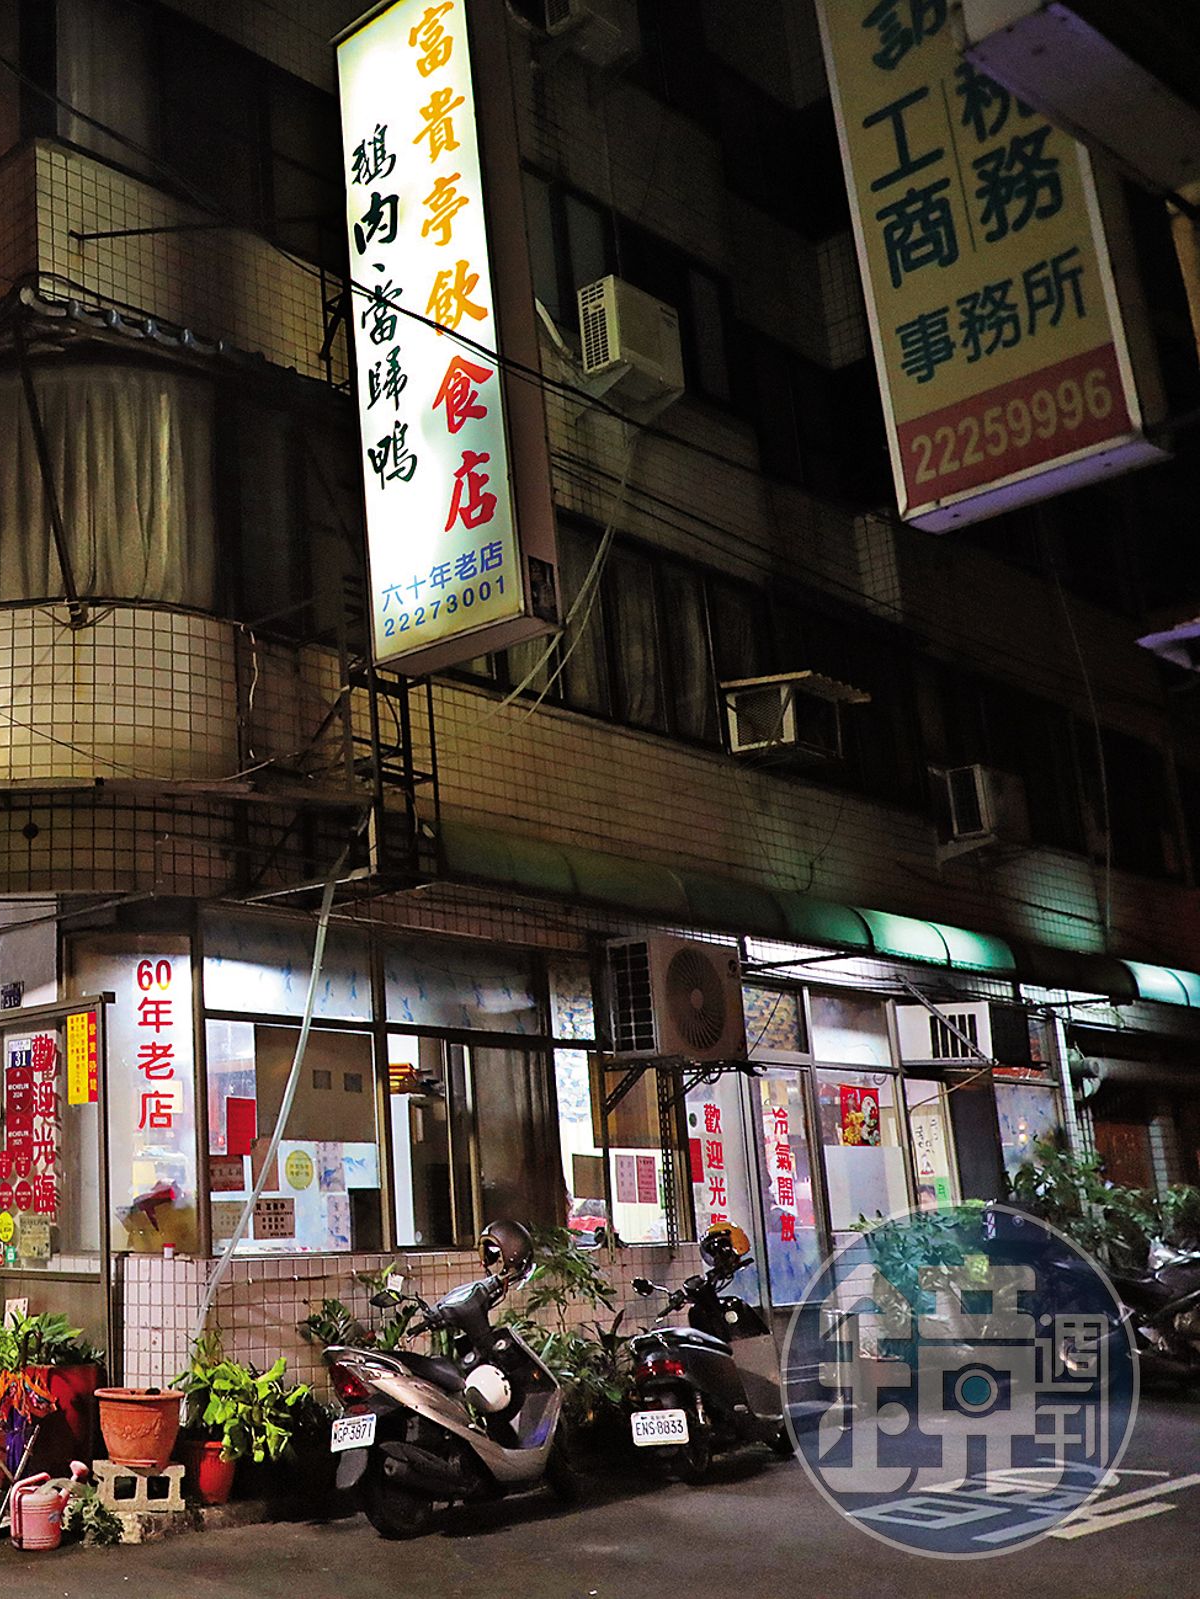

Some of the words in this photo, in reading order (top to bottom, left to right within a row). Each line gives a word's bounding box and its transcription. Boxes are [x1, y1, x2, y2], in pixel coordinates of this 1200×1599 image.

[408, 1, 499, 534] 富貴亭飲食店
[894, 246, 1087, 385] 事務所
[910, 370, 1114, 485] 22259996
[381, 539, 505, 612] 六十年老店
[384, 575, 506, 638] 22273001
[14, 1050, 27, 1067] 31
[135, 958, 176, 1130] 60年老店
[31, 1033, 57, 1213] 歡迎光臨
[771, 1107, 797, 1242] 冷氣開放
